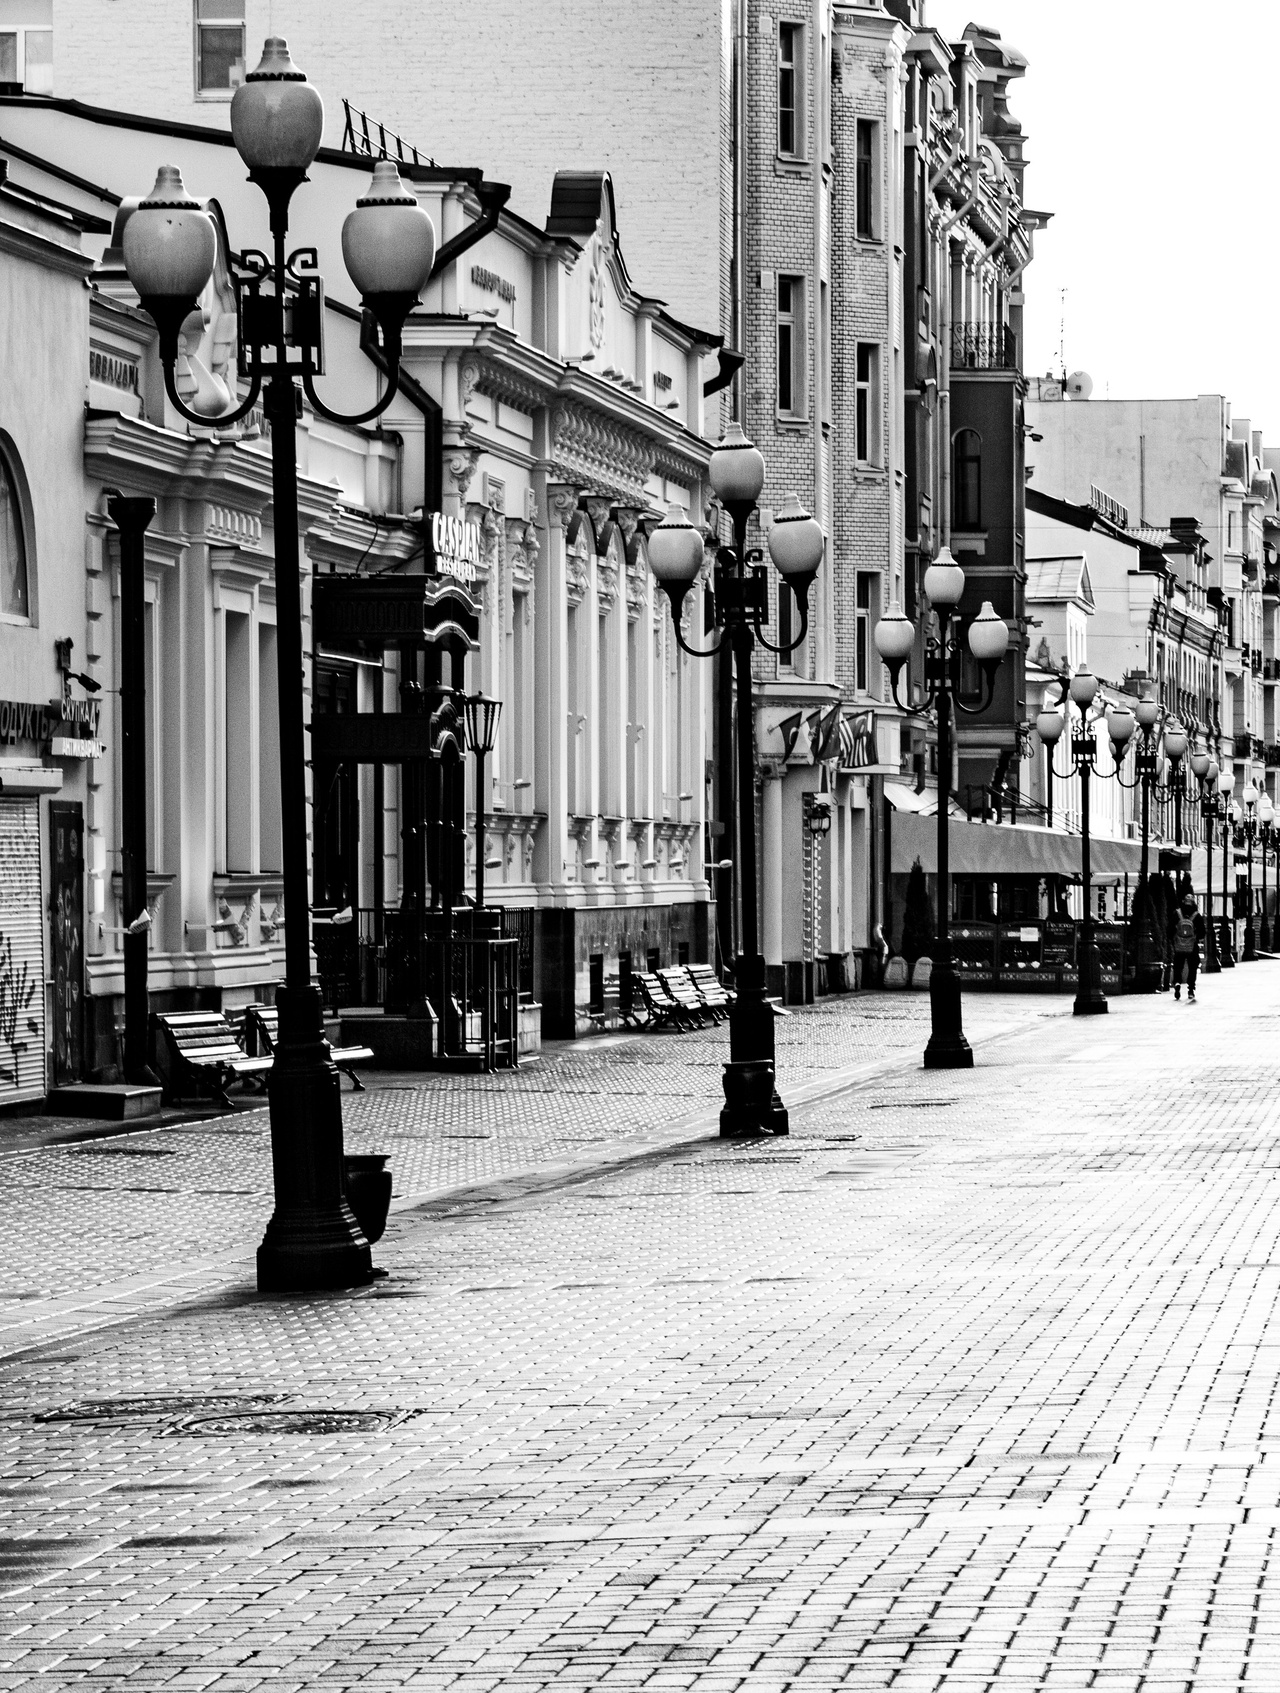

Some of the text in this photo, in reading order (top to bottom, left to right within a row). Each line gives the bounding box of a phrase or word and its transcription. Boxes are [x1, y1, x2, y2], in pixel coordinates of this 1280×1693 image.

[432, 511, 481, 562] CASPIAN
[0, 700, 51, 745] ОДУКТЫ
[61, 700, 90, 722] СКУПКА
[64, 888, 73, 1069] СКУПКА
